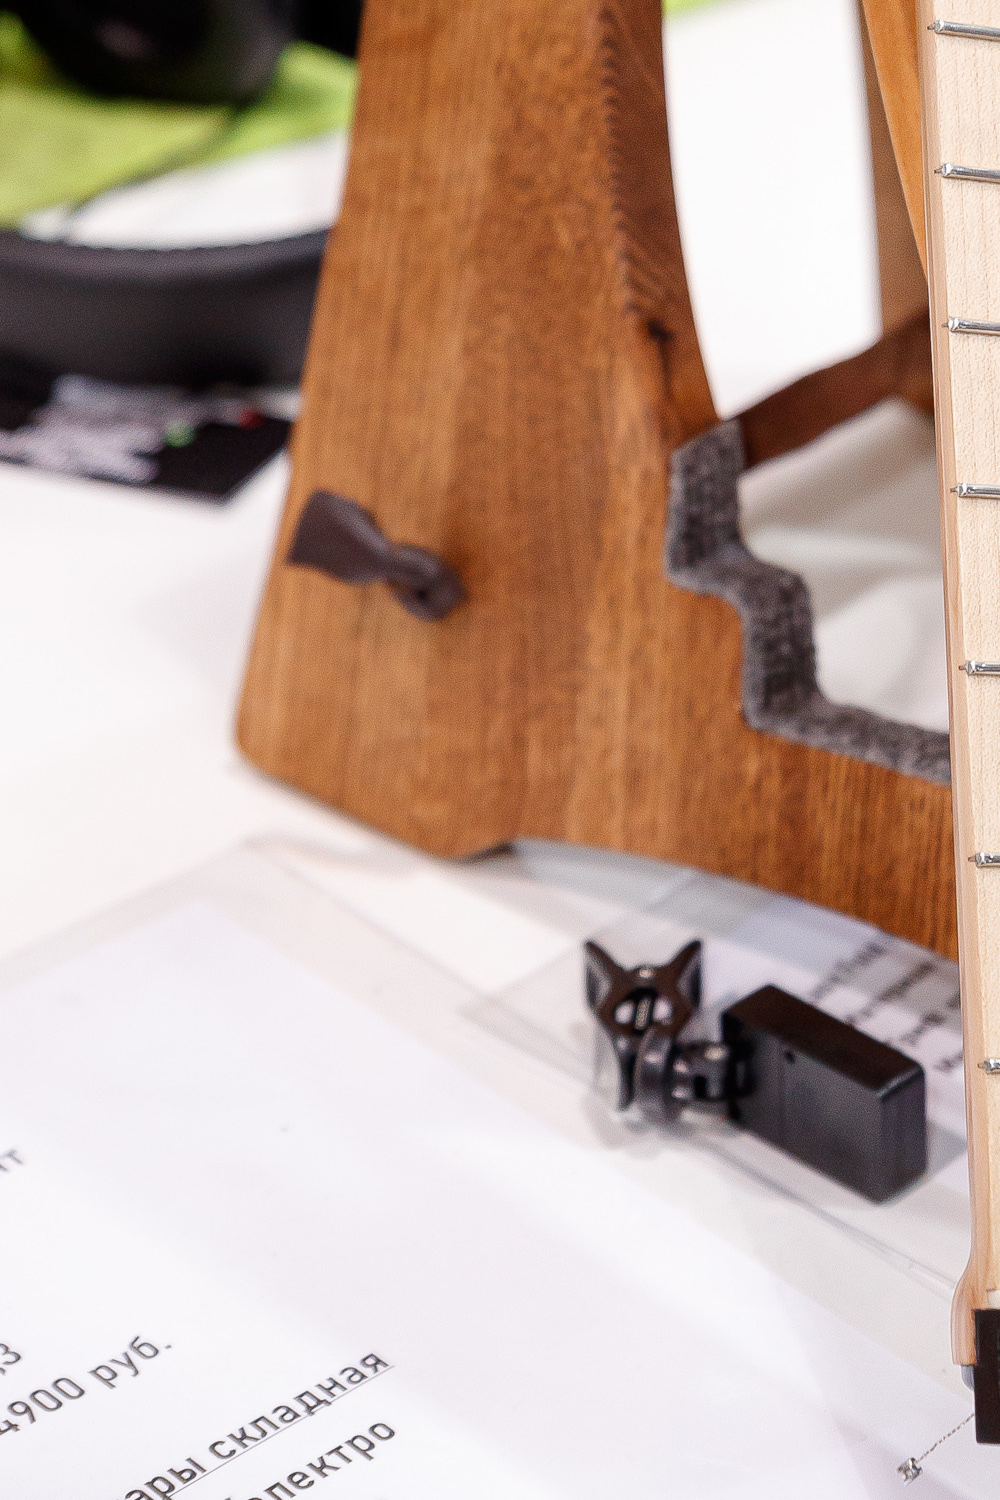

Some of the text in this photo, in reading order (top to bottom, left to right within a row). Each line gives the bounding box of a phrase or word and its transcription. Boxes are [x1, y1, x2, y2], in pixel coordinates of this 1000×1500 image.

[88, 1335, 172, 1389] руб.
[124, 1352, 389, 1500] ары складная
